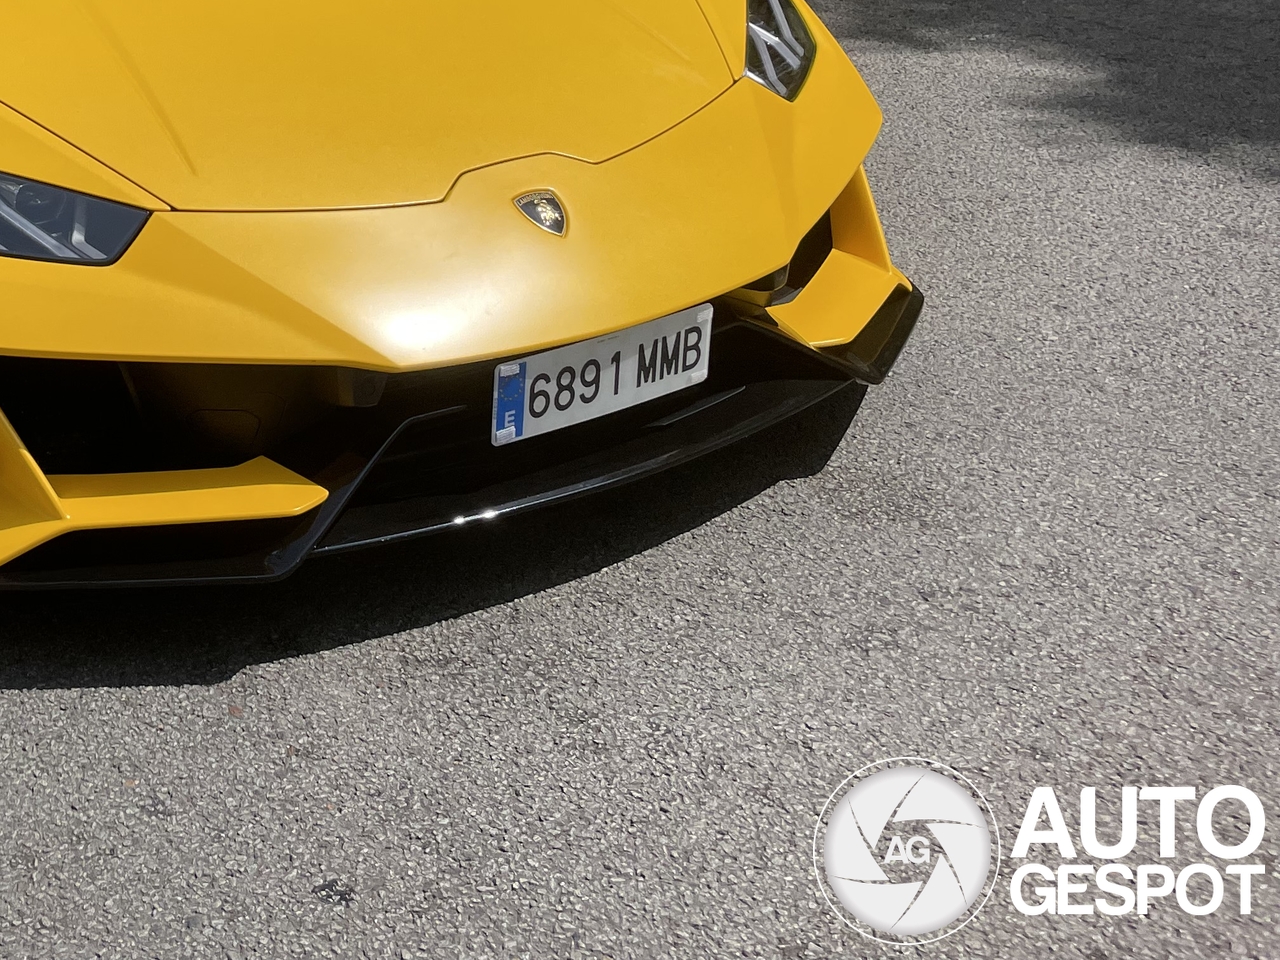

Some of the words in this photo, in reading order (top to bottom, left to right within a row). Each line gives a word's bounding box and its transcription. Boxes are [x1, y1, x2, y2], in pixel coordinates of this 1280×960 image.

[528, 350, 621, 419] 6891
[636, 326, 702, 388] MMB
[505, 410, 516, 427] E
